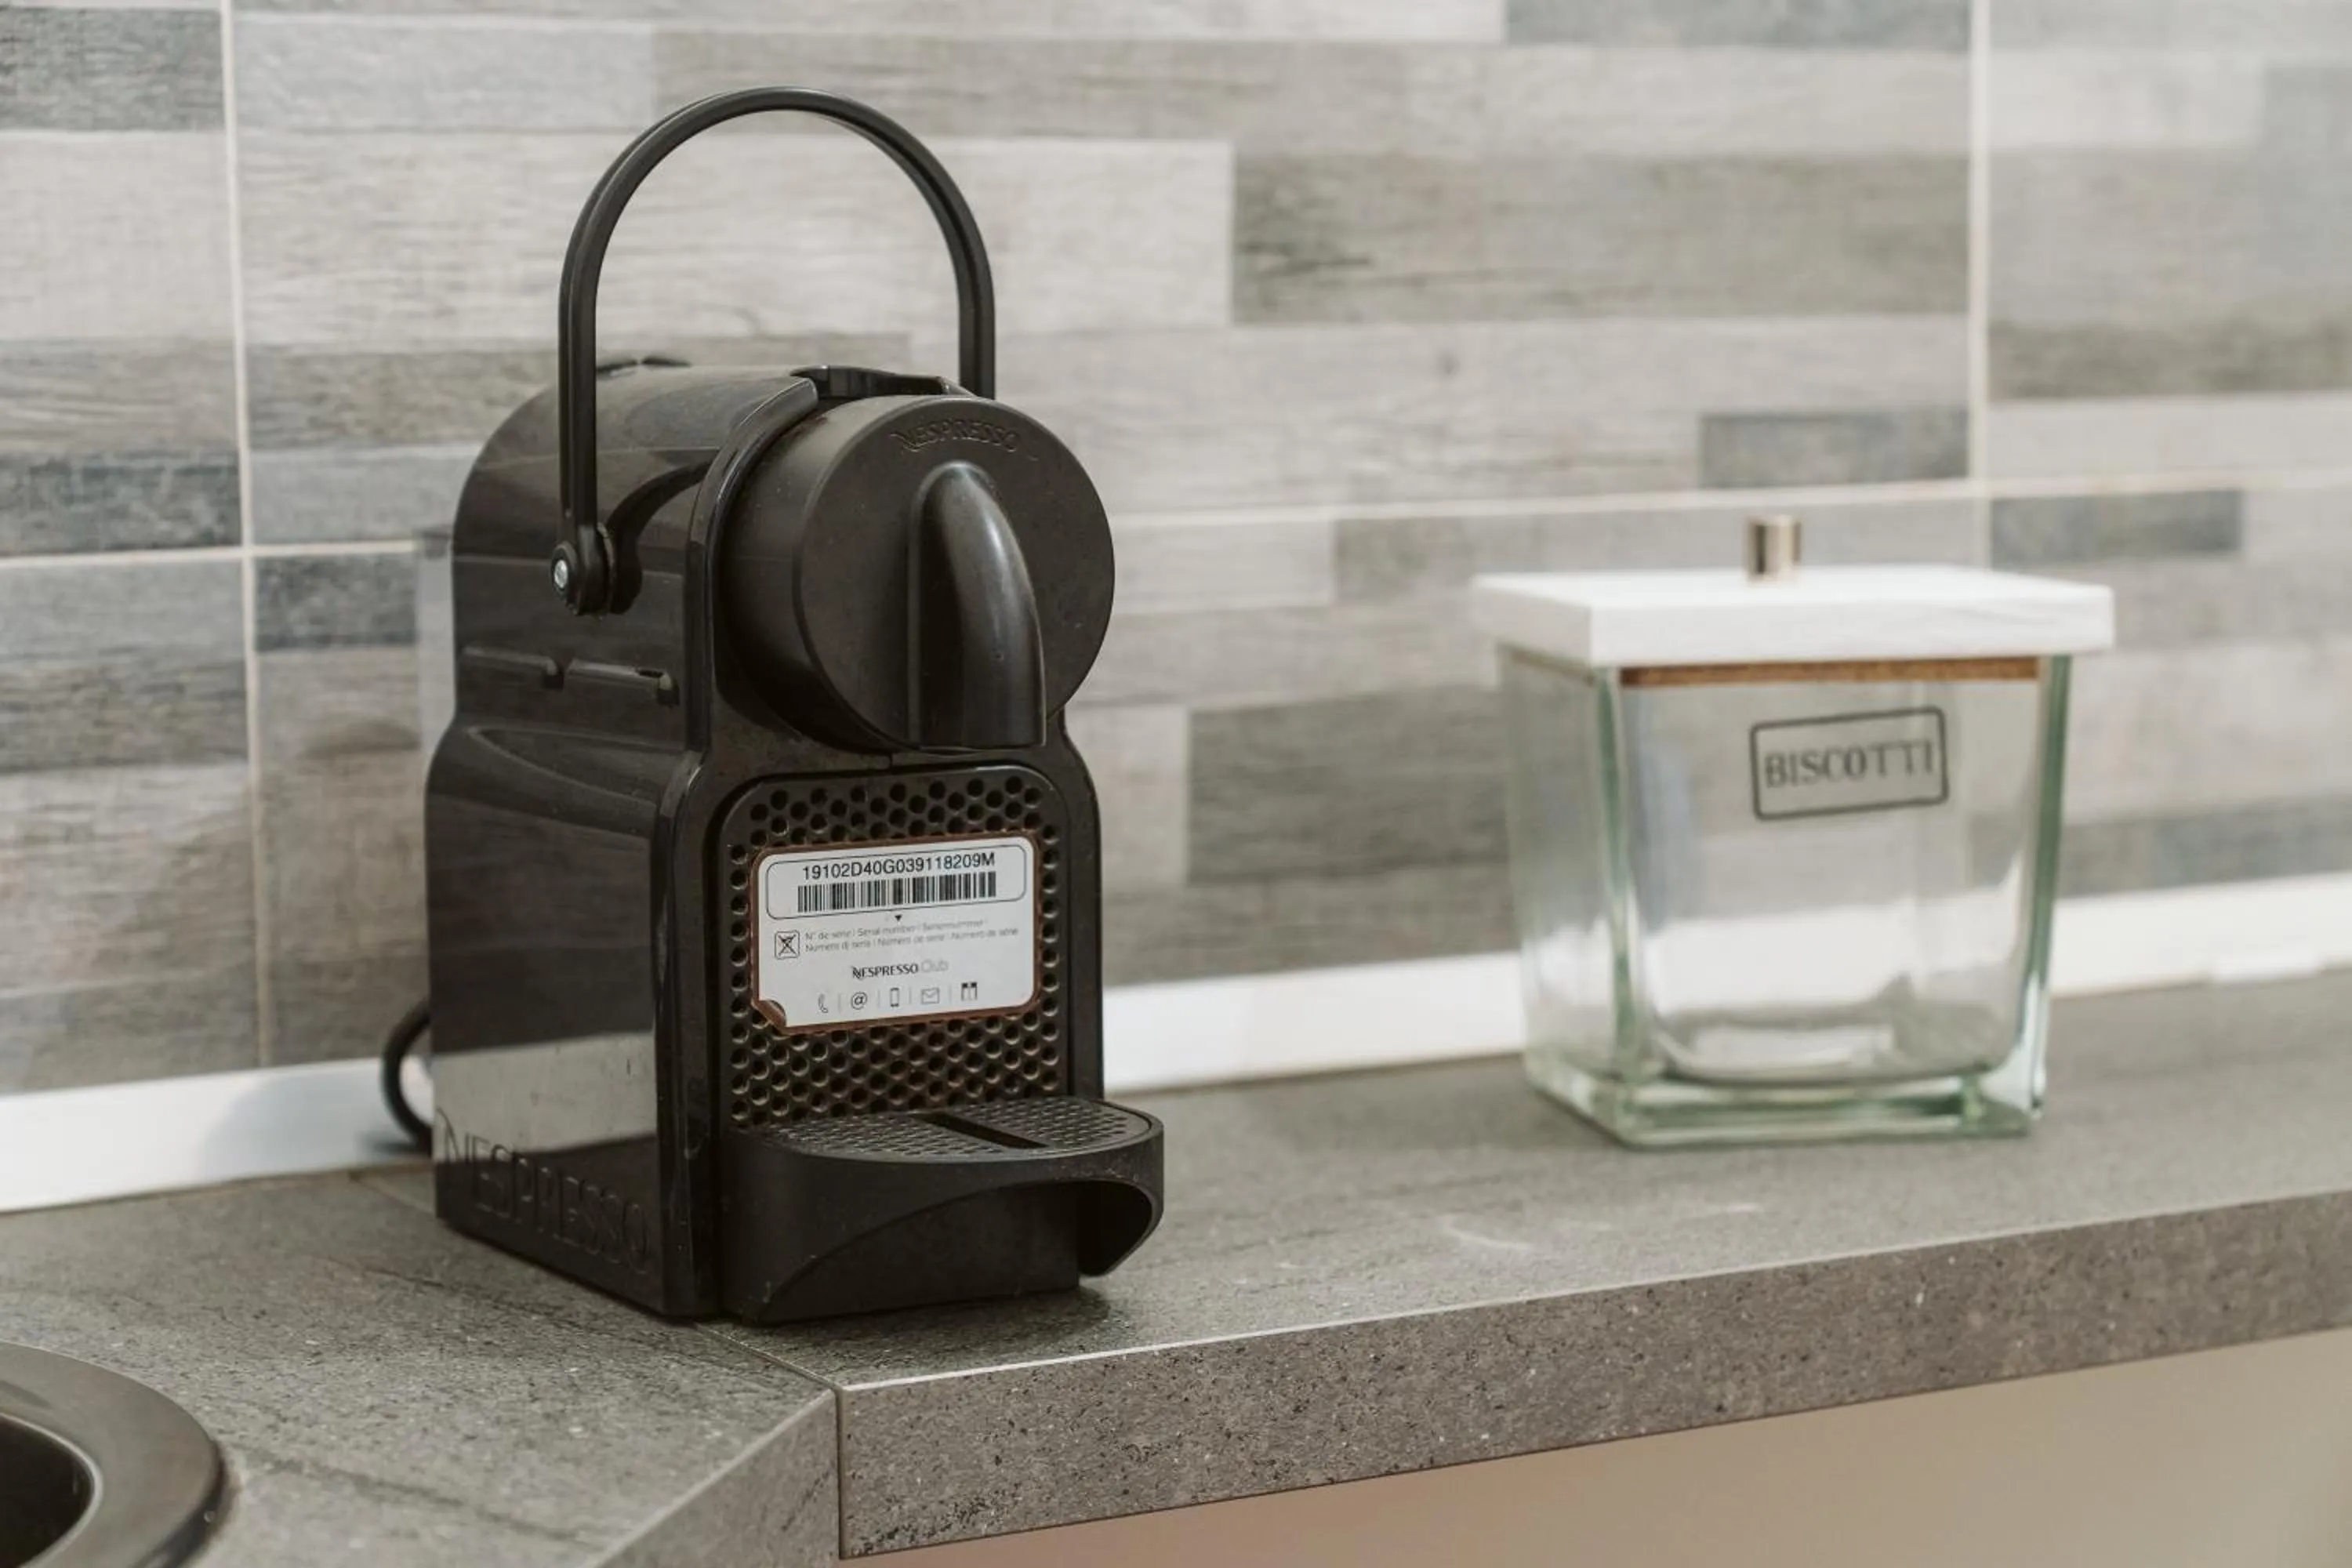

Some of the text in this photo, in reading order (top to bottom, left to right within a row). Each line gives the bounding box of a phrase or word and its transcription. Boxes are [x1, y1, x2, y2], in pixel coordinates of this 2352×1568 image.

[890, 418, 1018, 452] NESPRESSO
[1765, 741, 1934, 788] BISCOTTI
[802, 852, 996, 880] 19102D40G039118209M
[851, 963, 919, 979] NESPRESSO
